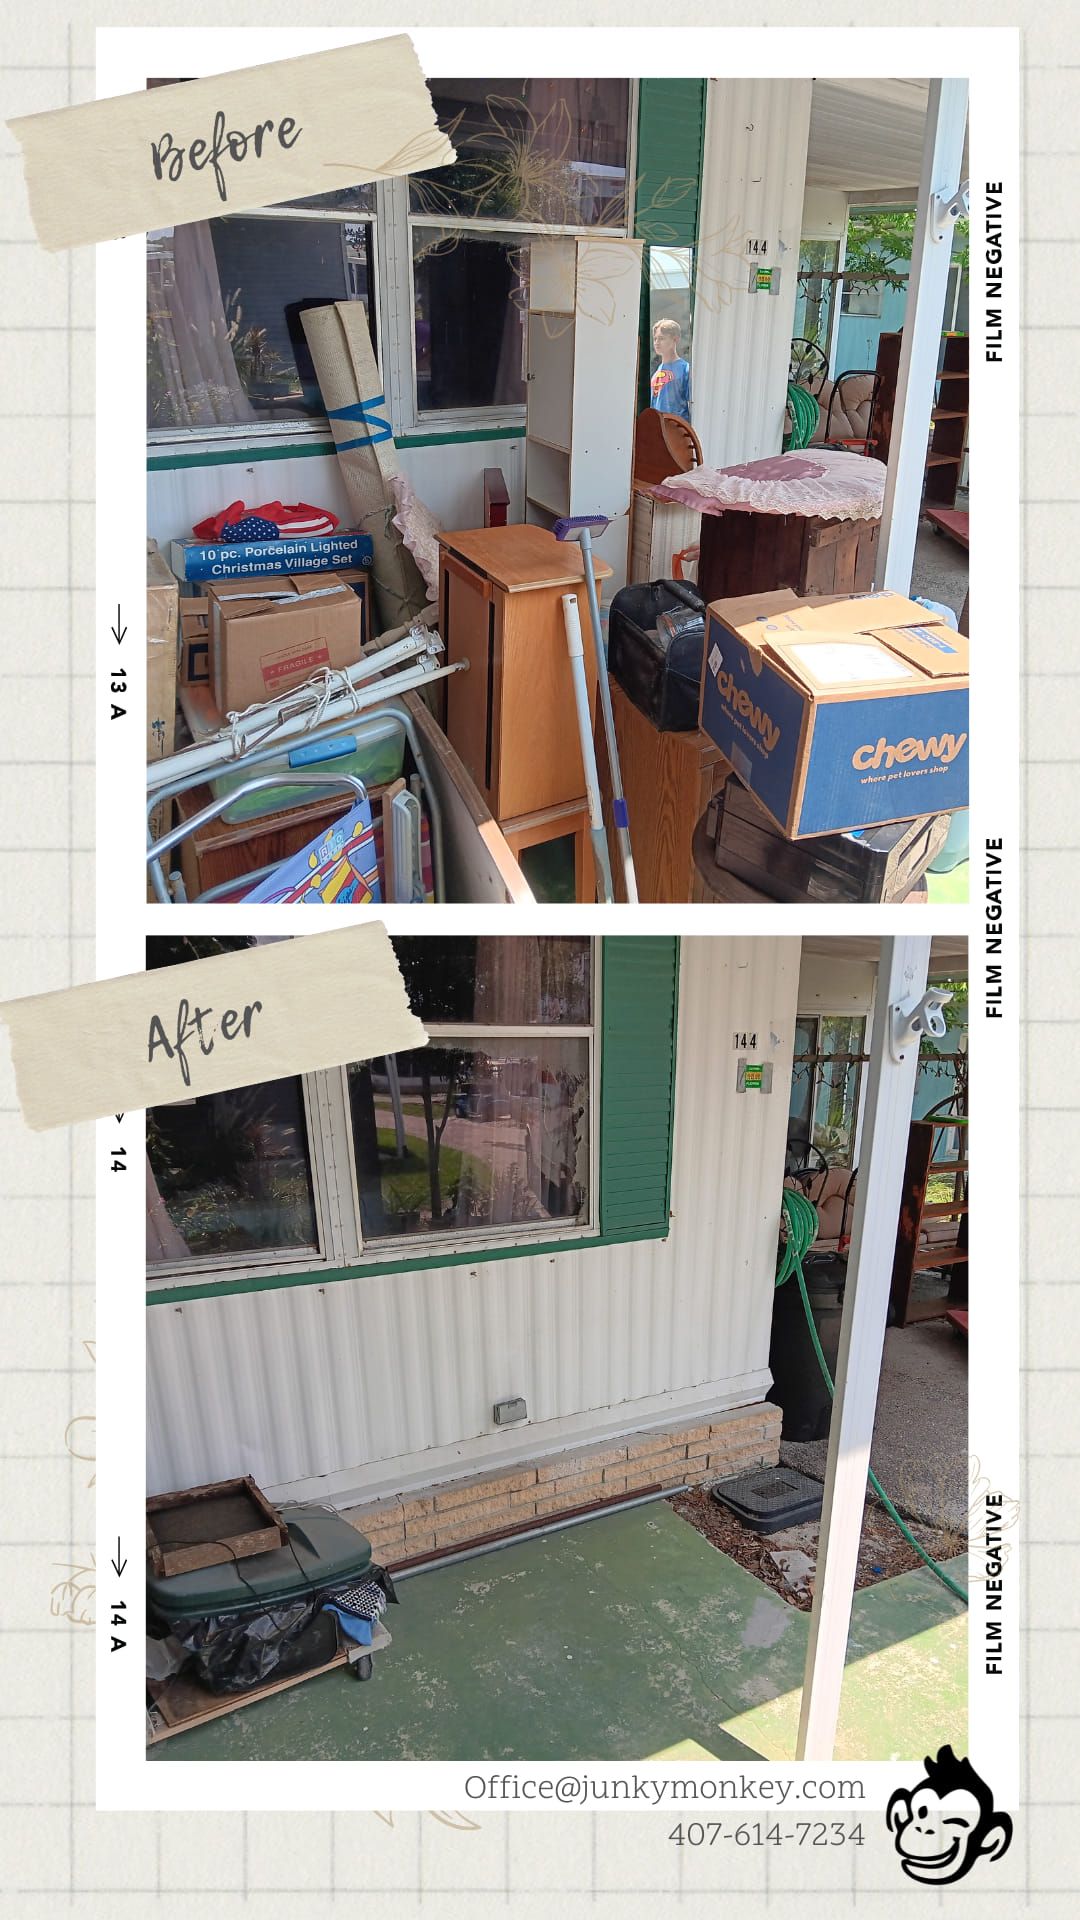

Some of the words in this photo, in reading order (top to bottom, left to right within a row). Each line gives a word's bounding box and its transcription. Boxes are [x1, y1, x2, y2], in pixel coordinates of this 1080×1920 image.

[748, 240, 767, 254] 144
[200, 550, 215, 561] 10
[221, 551, 241, 562] pc.
[245, 541, 307, 558] Porcelain
[311, 540, 358, 555] Lighted
[211, 560, 282, 575] Christmas
[285, 557, 328, 569] Village
[332, 555, 353, 565] Set
[278, 656, 314, 673] FRAGILE
[717, 671, 781, 752] chewy
[852, 733, 967, 770] chewy
[860, 775, 886, 784] where
[888, 771, 902, 782] pet
[904, 768, 928, 778] lovers
[929, 765, 949, 774] shop
[735, 1033, 757, 1049] 144
